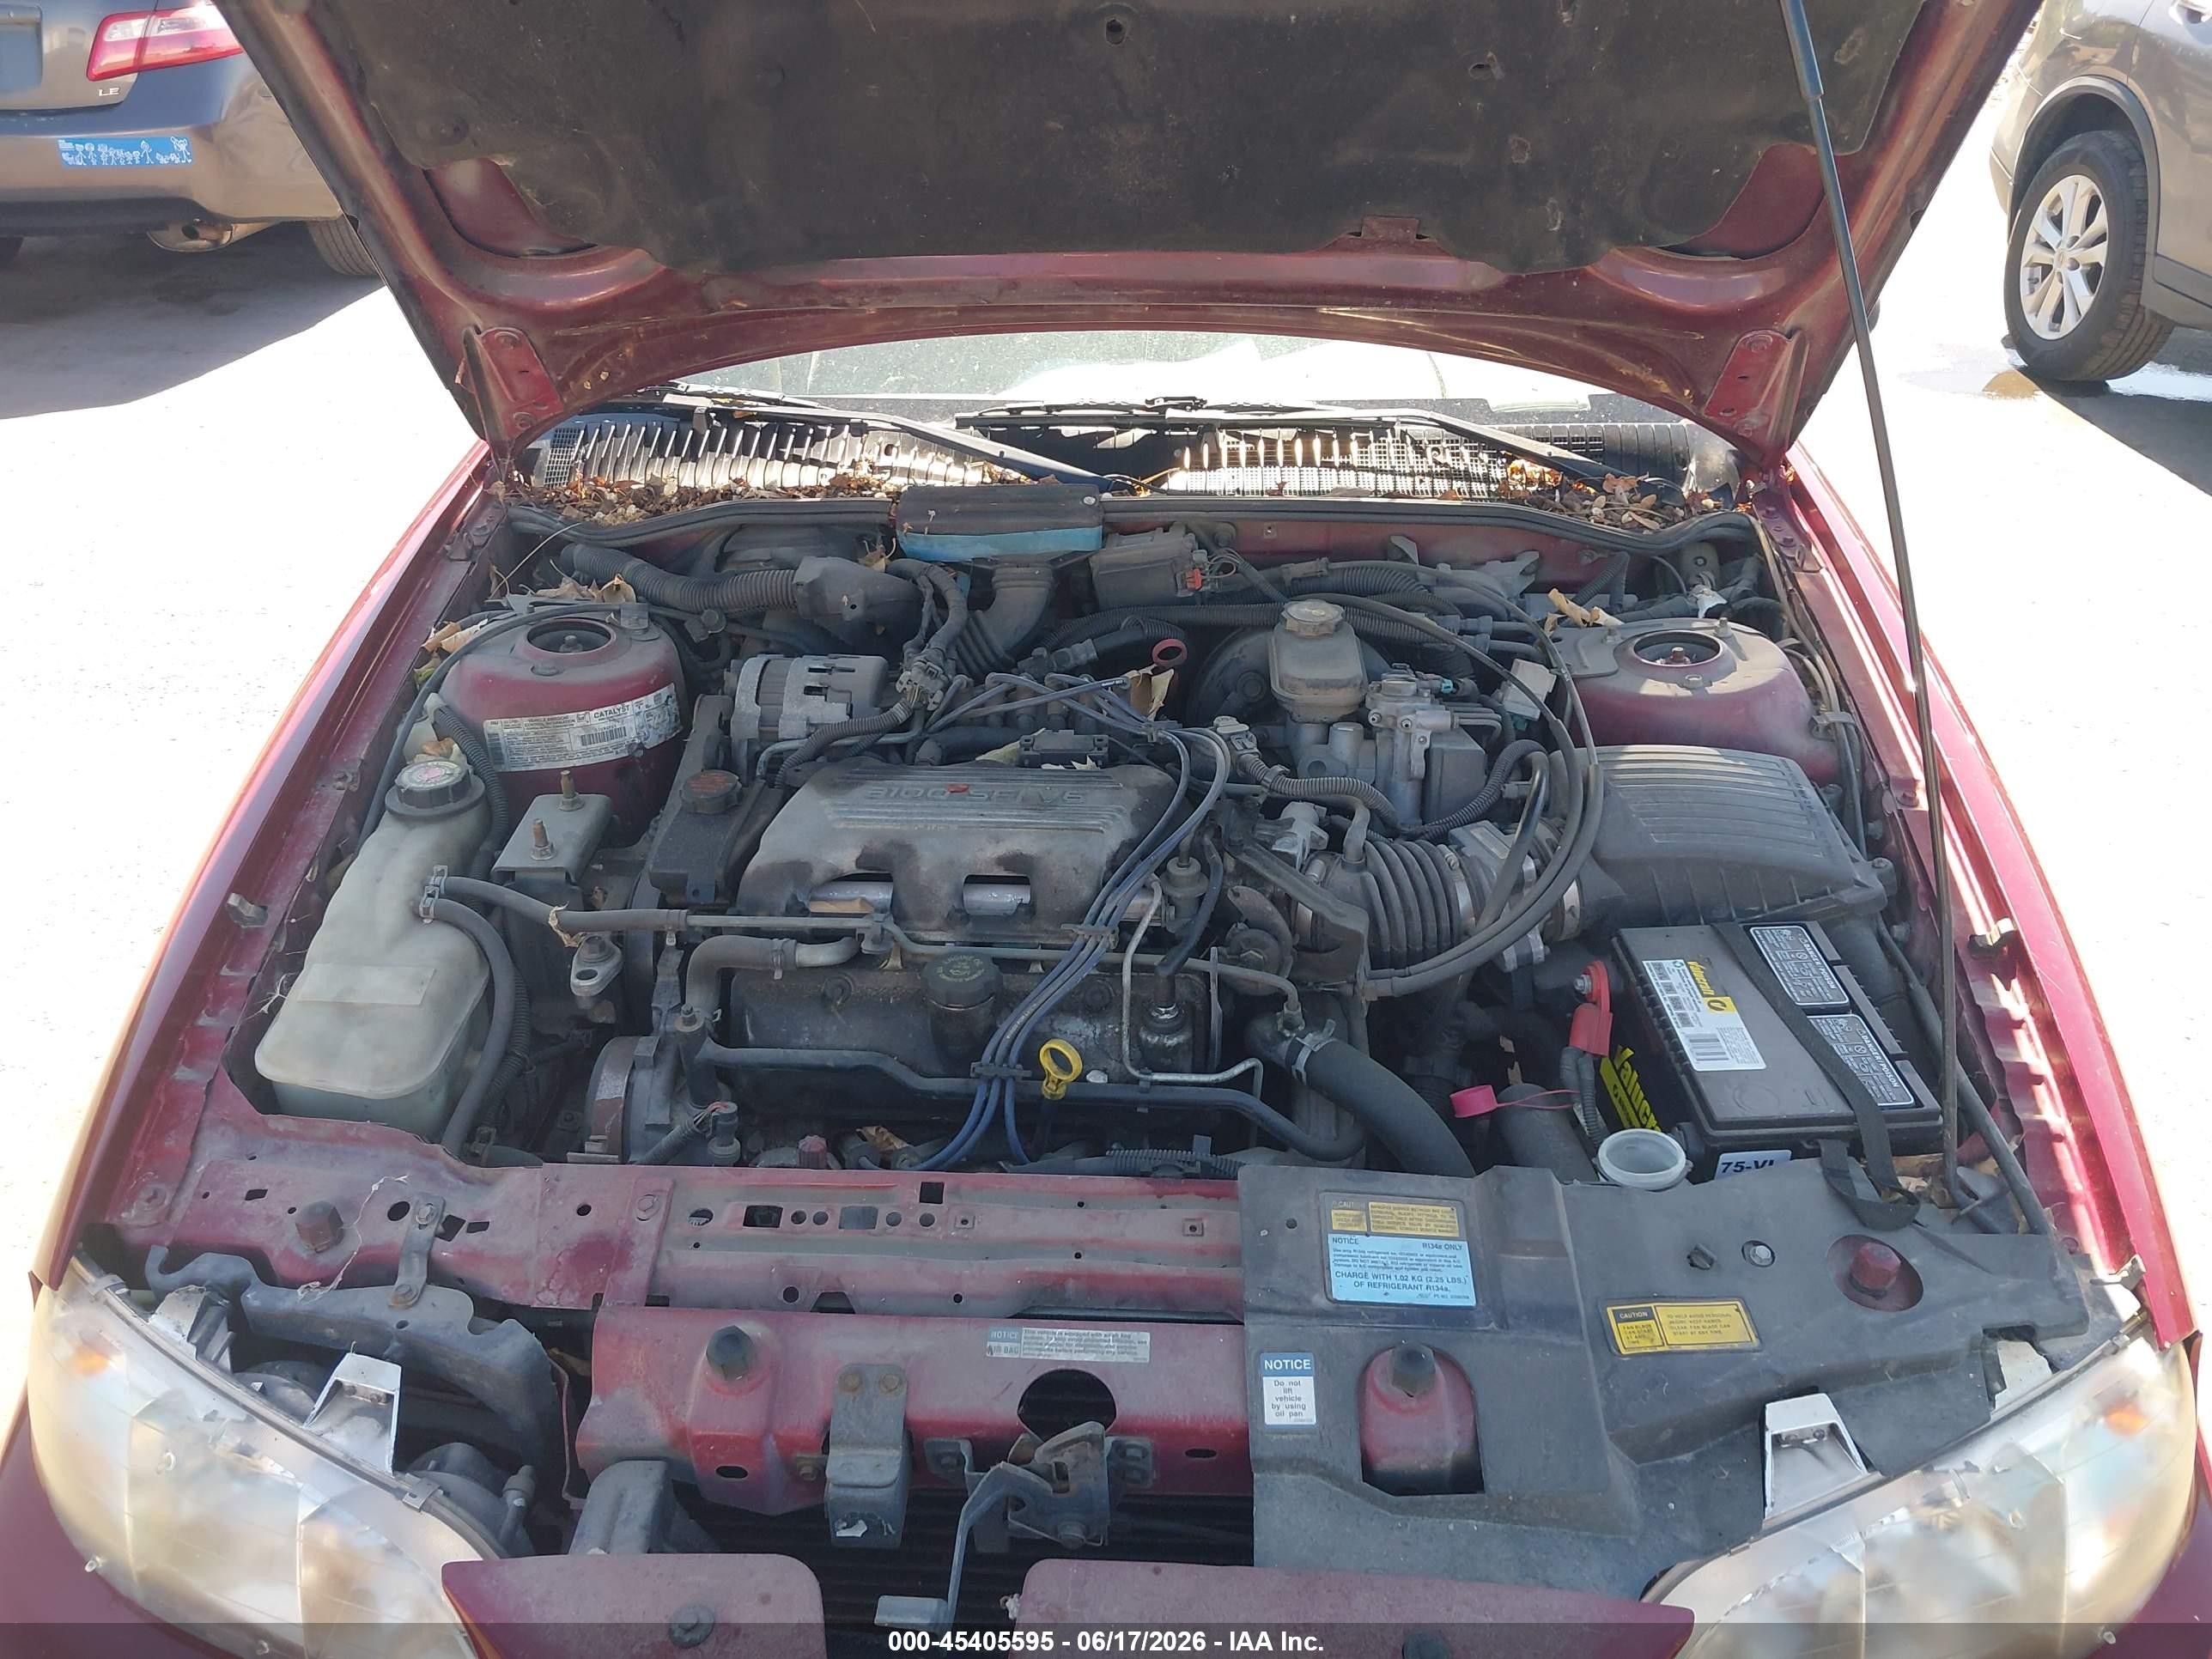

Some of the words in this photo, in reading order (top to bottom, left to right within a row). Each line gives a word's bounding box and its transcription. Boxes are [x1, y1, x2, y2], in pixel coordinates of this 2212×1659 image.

[99, 88, 119, 96] LE
[593, 705, 630, 719] CATALYST
[1335, 1271, 1369, 1279] CHARGE
[1003, 1346, 1018, 1354] BAG
[1264, 1359, 1311, 1370] NOTICE
